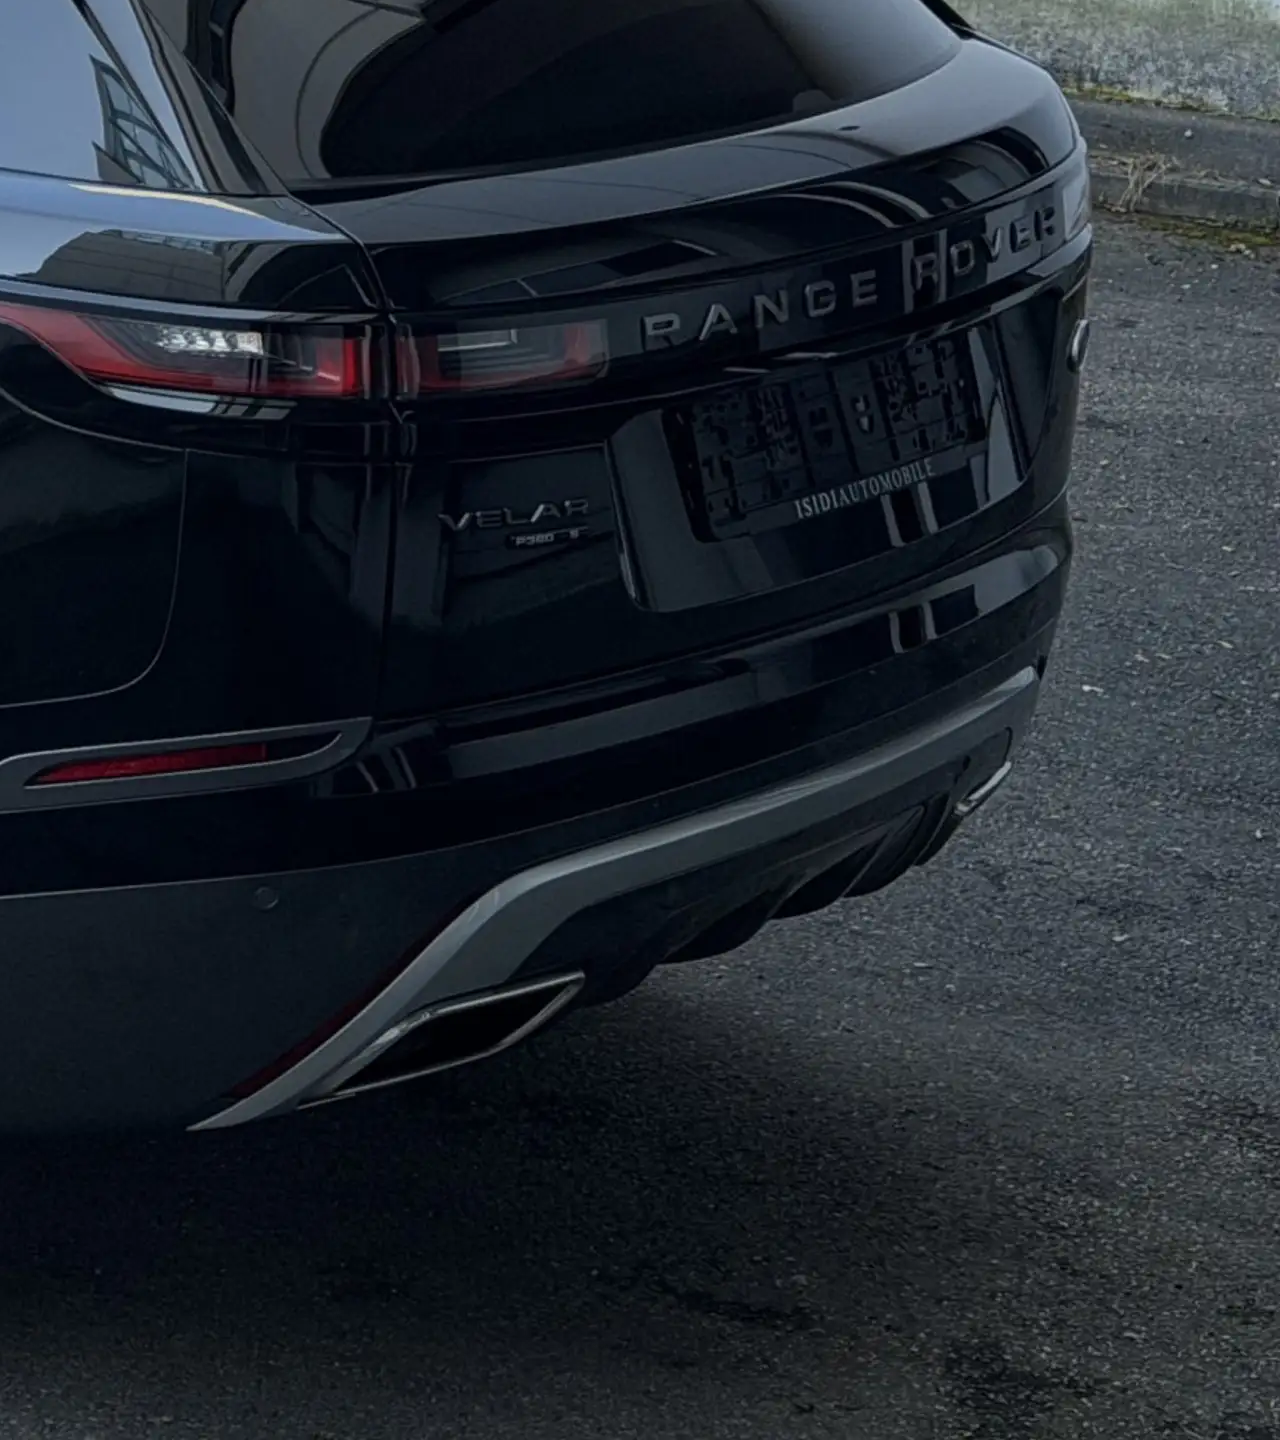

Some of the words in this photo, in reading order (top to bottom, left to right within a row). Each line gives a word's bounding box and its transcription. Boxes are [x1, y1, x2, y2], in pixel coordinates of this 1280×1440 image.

[641, 268, 878, 352] RANGE
[911, 205, 1057, 292] ROVER
[436, 496, 590, 532] VELAR
[793, 457, 937, 520] ISIDIAUTOMOBILE
